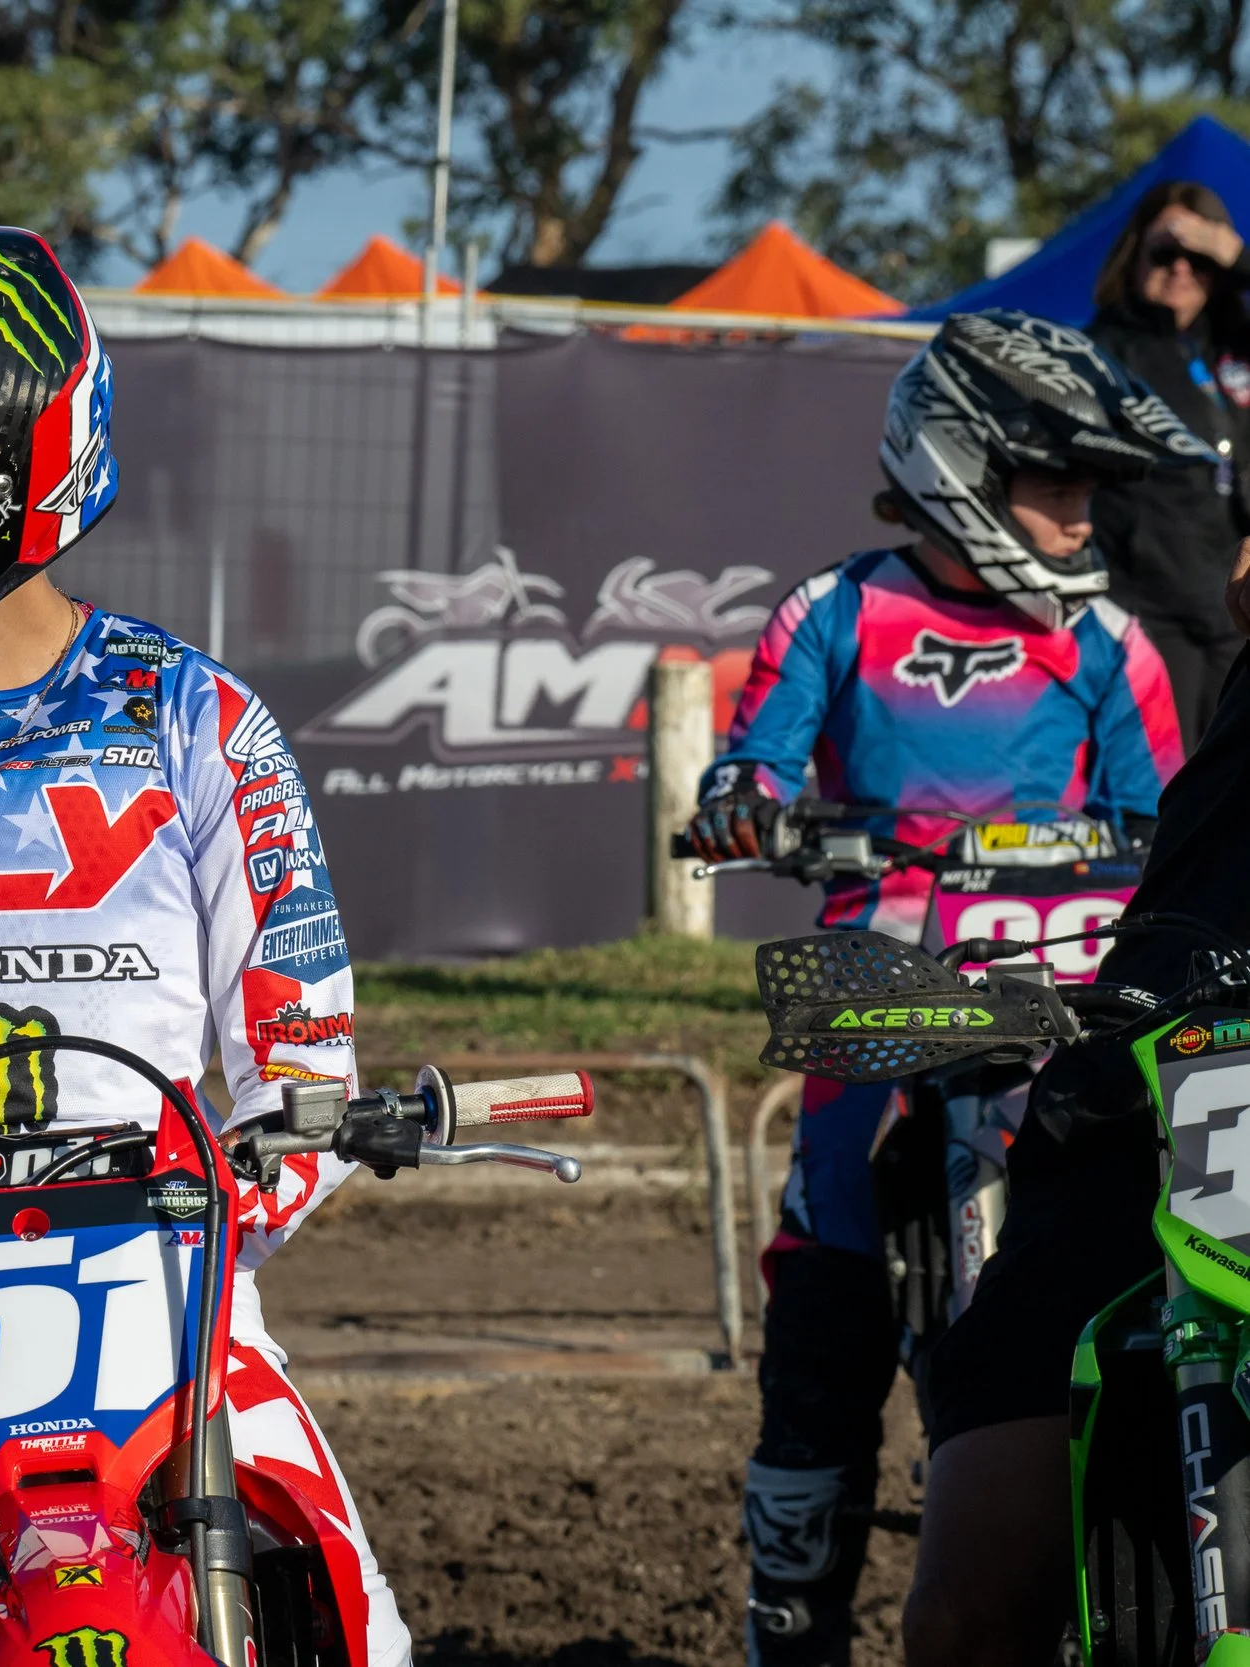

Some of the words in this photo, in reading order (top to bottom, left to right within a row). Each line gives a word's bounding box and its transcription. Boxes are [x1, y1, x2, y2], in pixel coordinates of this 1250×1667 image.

[237, 753, 300, 788] HOND
[274, 900, 336, 914] FUN-MAKERS
[1170, 1031, 1212, 1047] PENRITE
[8, 1417, 96, 1436] HONDA
[20, 1434, 87, 1451] THROTTLE
[1180, 1402, 1228, 1634] CHASE
